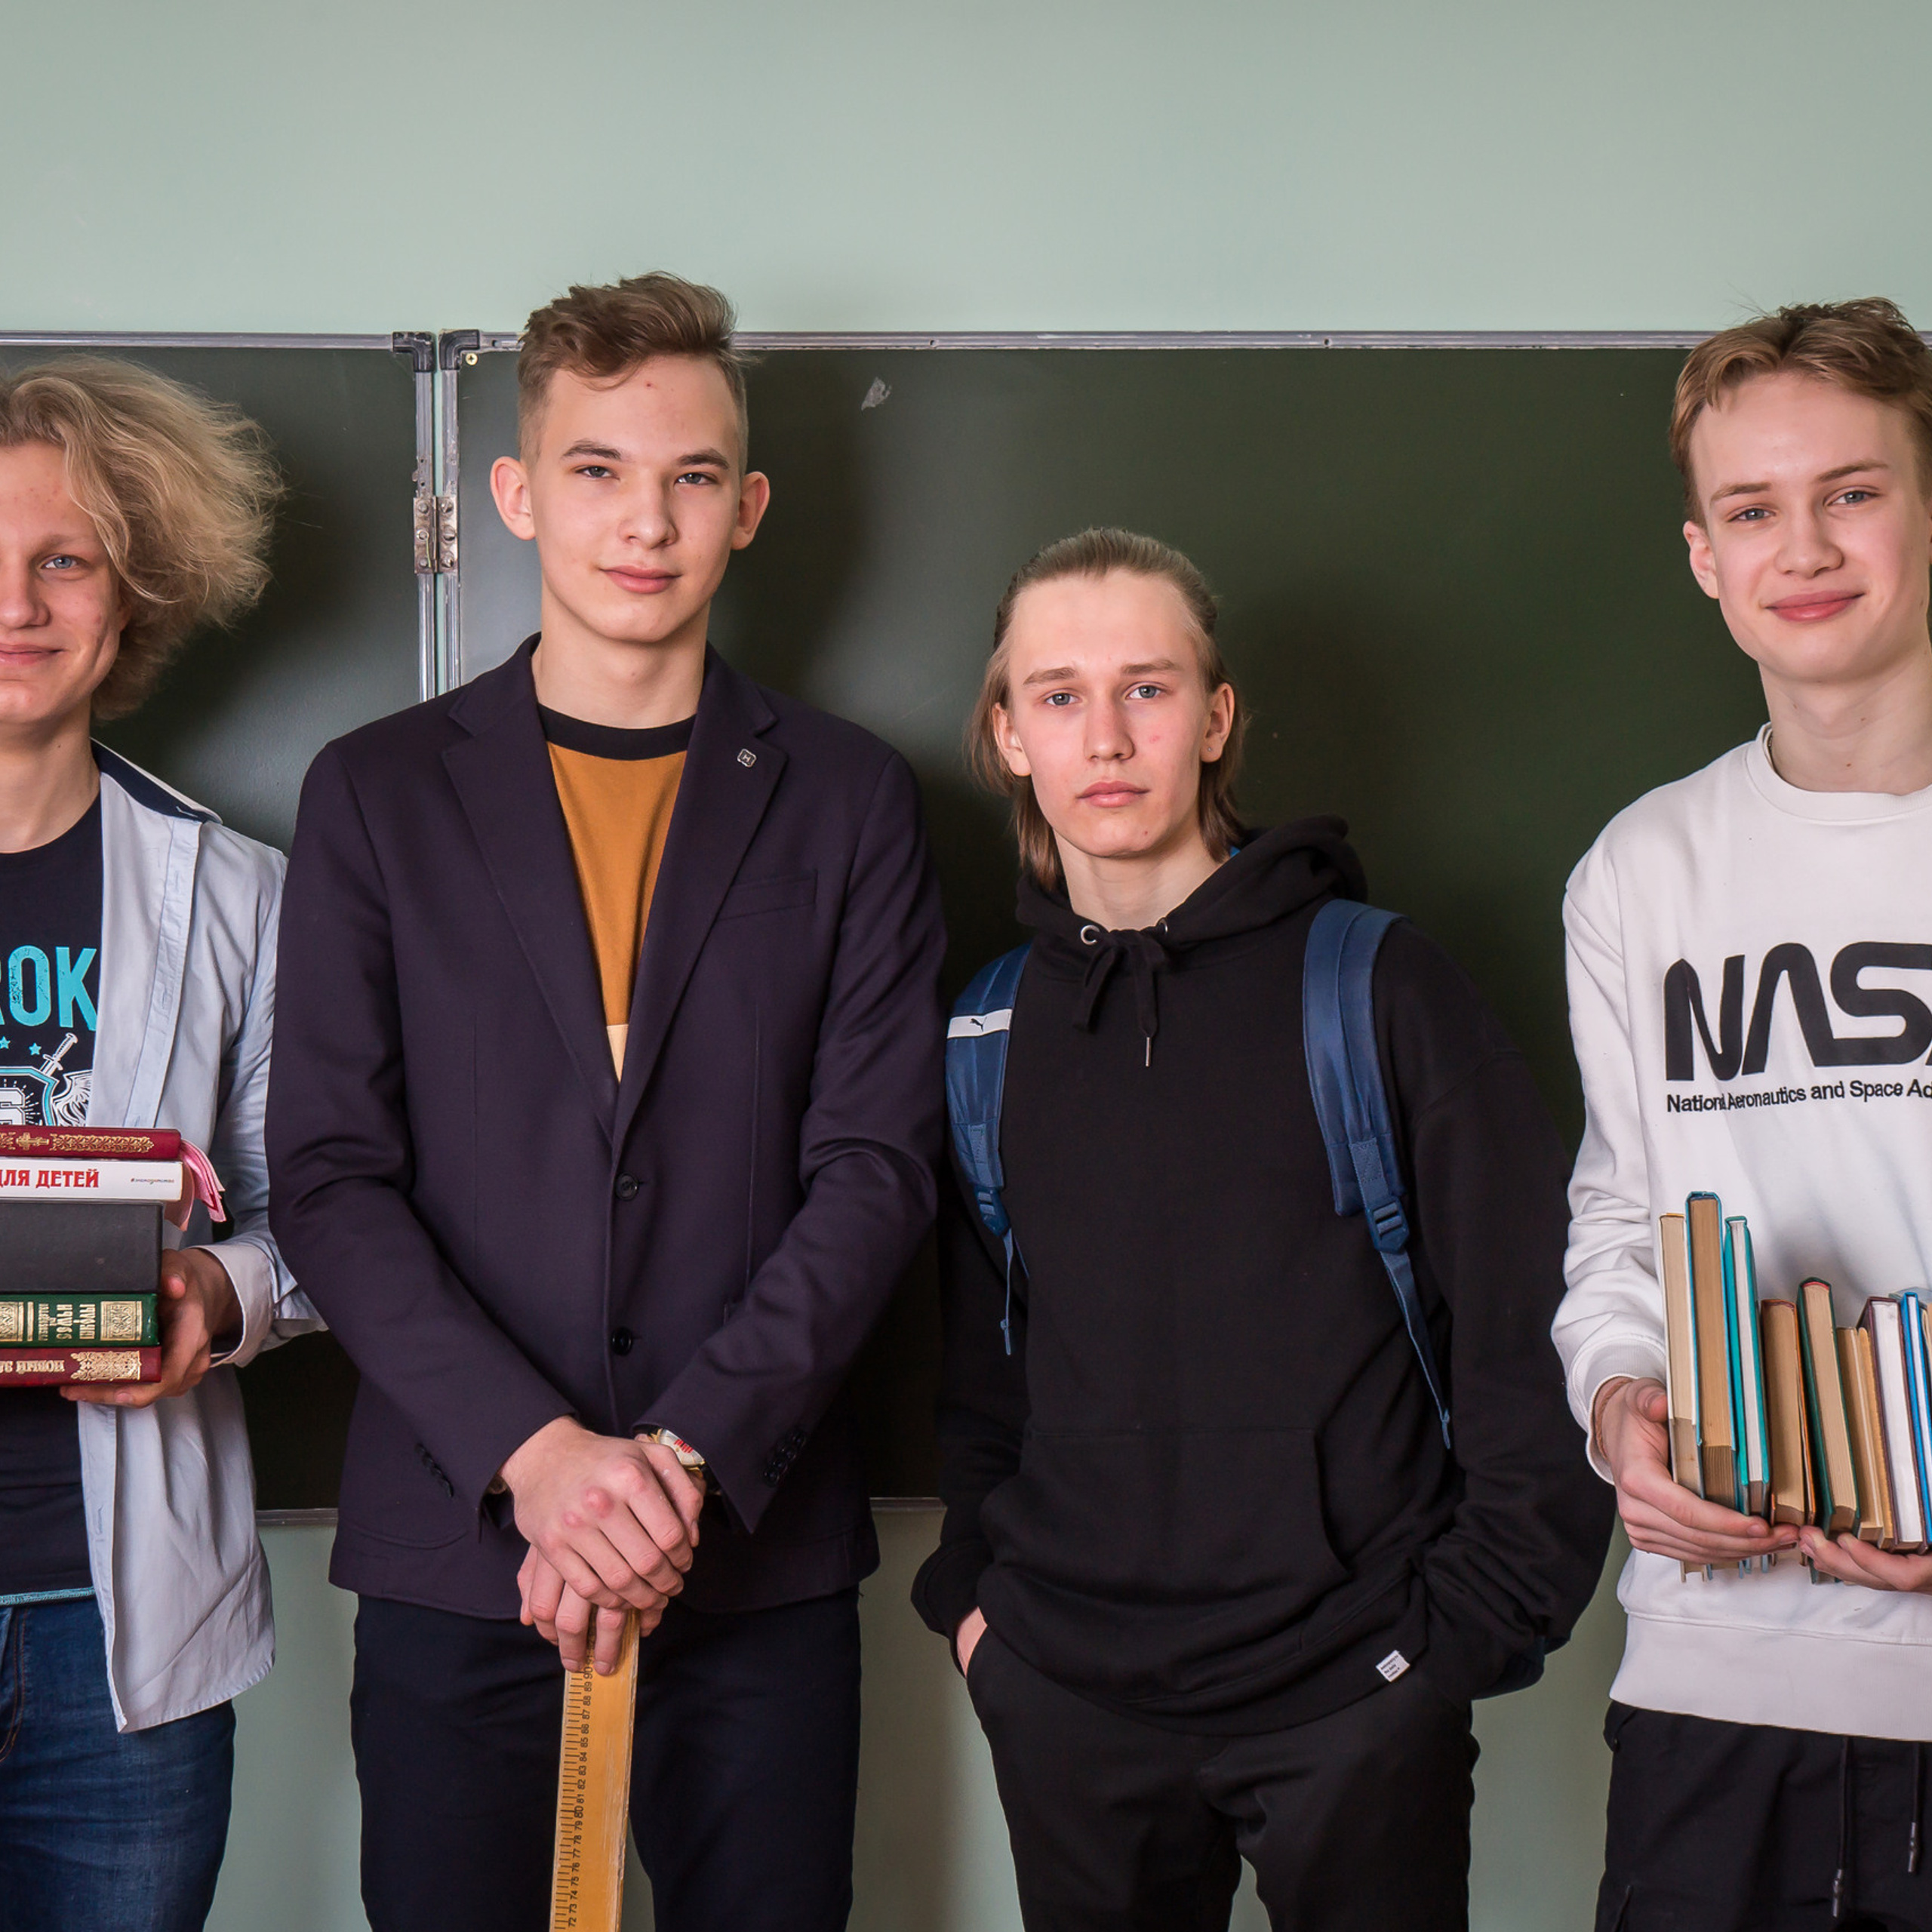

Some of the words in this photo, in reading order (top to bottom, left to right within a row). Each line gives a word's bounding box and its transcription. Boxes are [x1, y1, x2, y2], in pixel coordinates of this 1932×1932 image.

[0, 945, 97, 1032] OK
[1663, 942, 1932, 1081] NAS
[1727, 1087, 1806, 1110] Aeronautics
[1810, 1081, 1844, 1100] and
[1850, 1080, 1903, 1103] Space
[0, 1169, 30, 1188] ЛЯ
[35, 1168, 99, 1189] ДЕТЕЙ
[583, 1667, 593, 1679] 90
[584, 1681, 592, 1692] 89
[583, 1696, 592, 1706] 88
[582, 1709, 590, 1720] 87
[581, 1724, 589, 1734] 86
[580, 1737, 589, 1748] 85
[580, 1752, 587, 1762] 84
[579, 1766, 586, 1776] 83
[577, 1779, 586, 1789] 82
[577, 1794, 585, 1804] 81
[574, 1806, 584, 1819] 80
[574, 1821, 583, 1831] 79
[574, 1835, 582, 1845] 78
[573, 1848, 581, 1859] 77
[571, 1863, 580, 1873] 76
[571, 1876, 579, 1887] 75
[570, 1890, 578, 1900] 74
[569, 1903, 577, 1914] 73
[568, 1917, 577, 1927] 72
